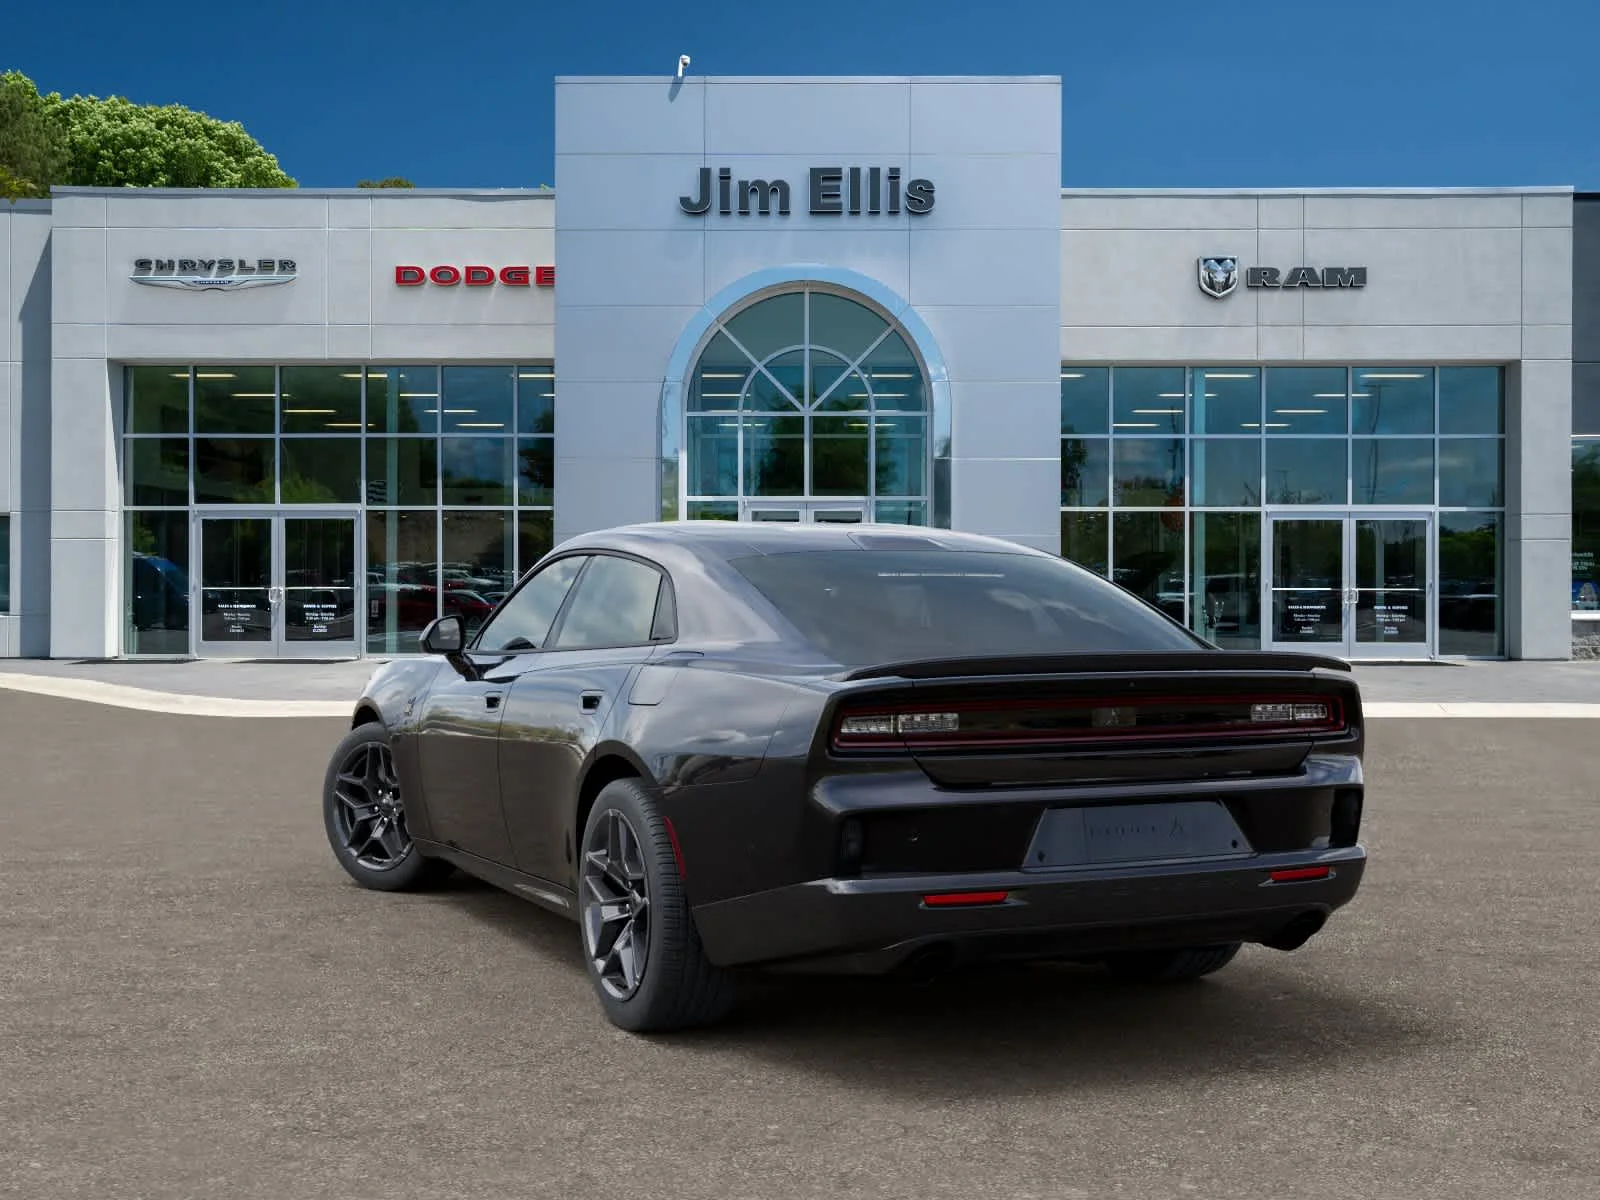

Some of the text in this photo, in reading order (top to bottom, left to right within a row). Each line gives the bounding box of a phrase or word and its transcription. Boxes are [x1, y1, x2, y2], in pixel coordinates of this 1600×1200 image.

[679, 167, 936, 214] Jim Ellis
[134, 258, 297, 272] CHRYSLER
[395, 265, 555, 286] DODGE
[1247, 267, 1367, 288] RAM
